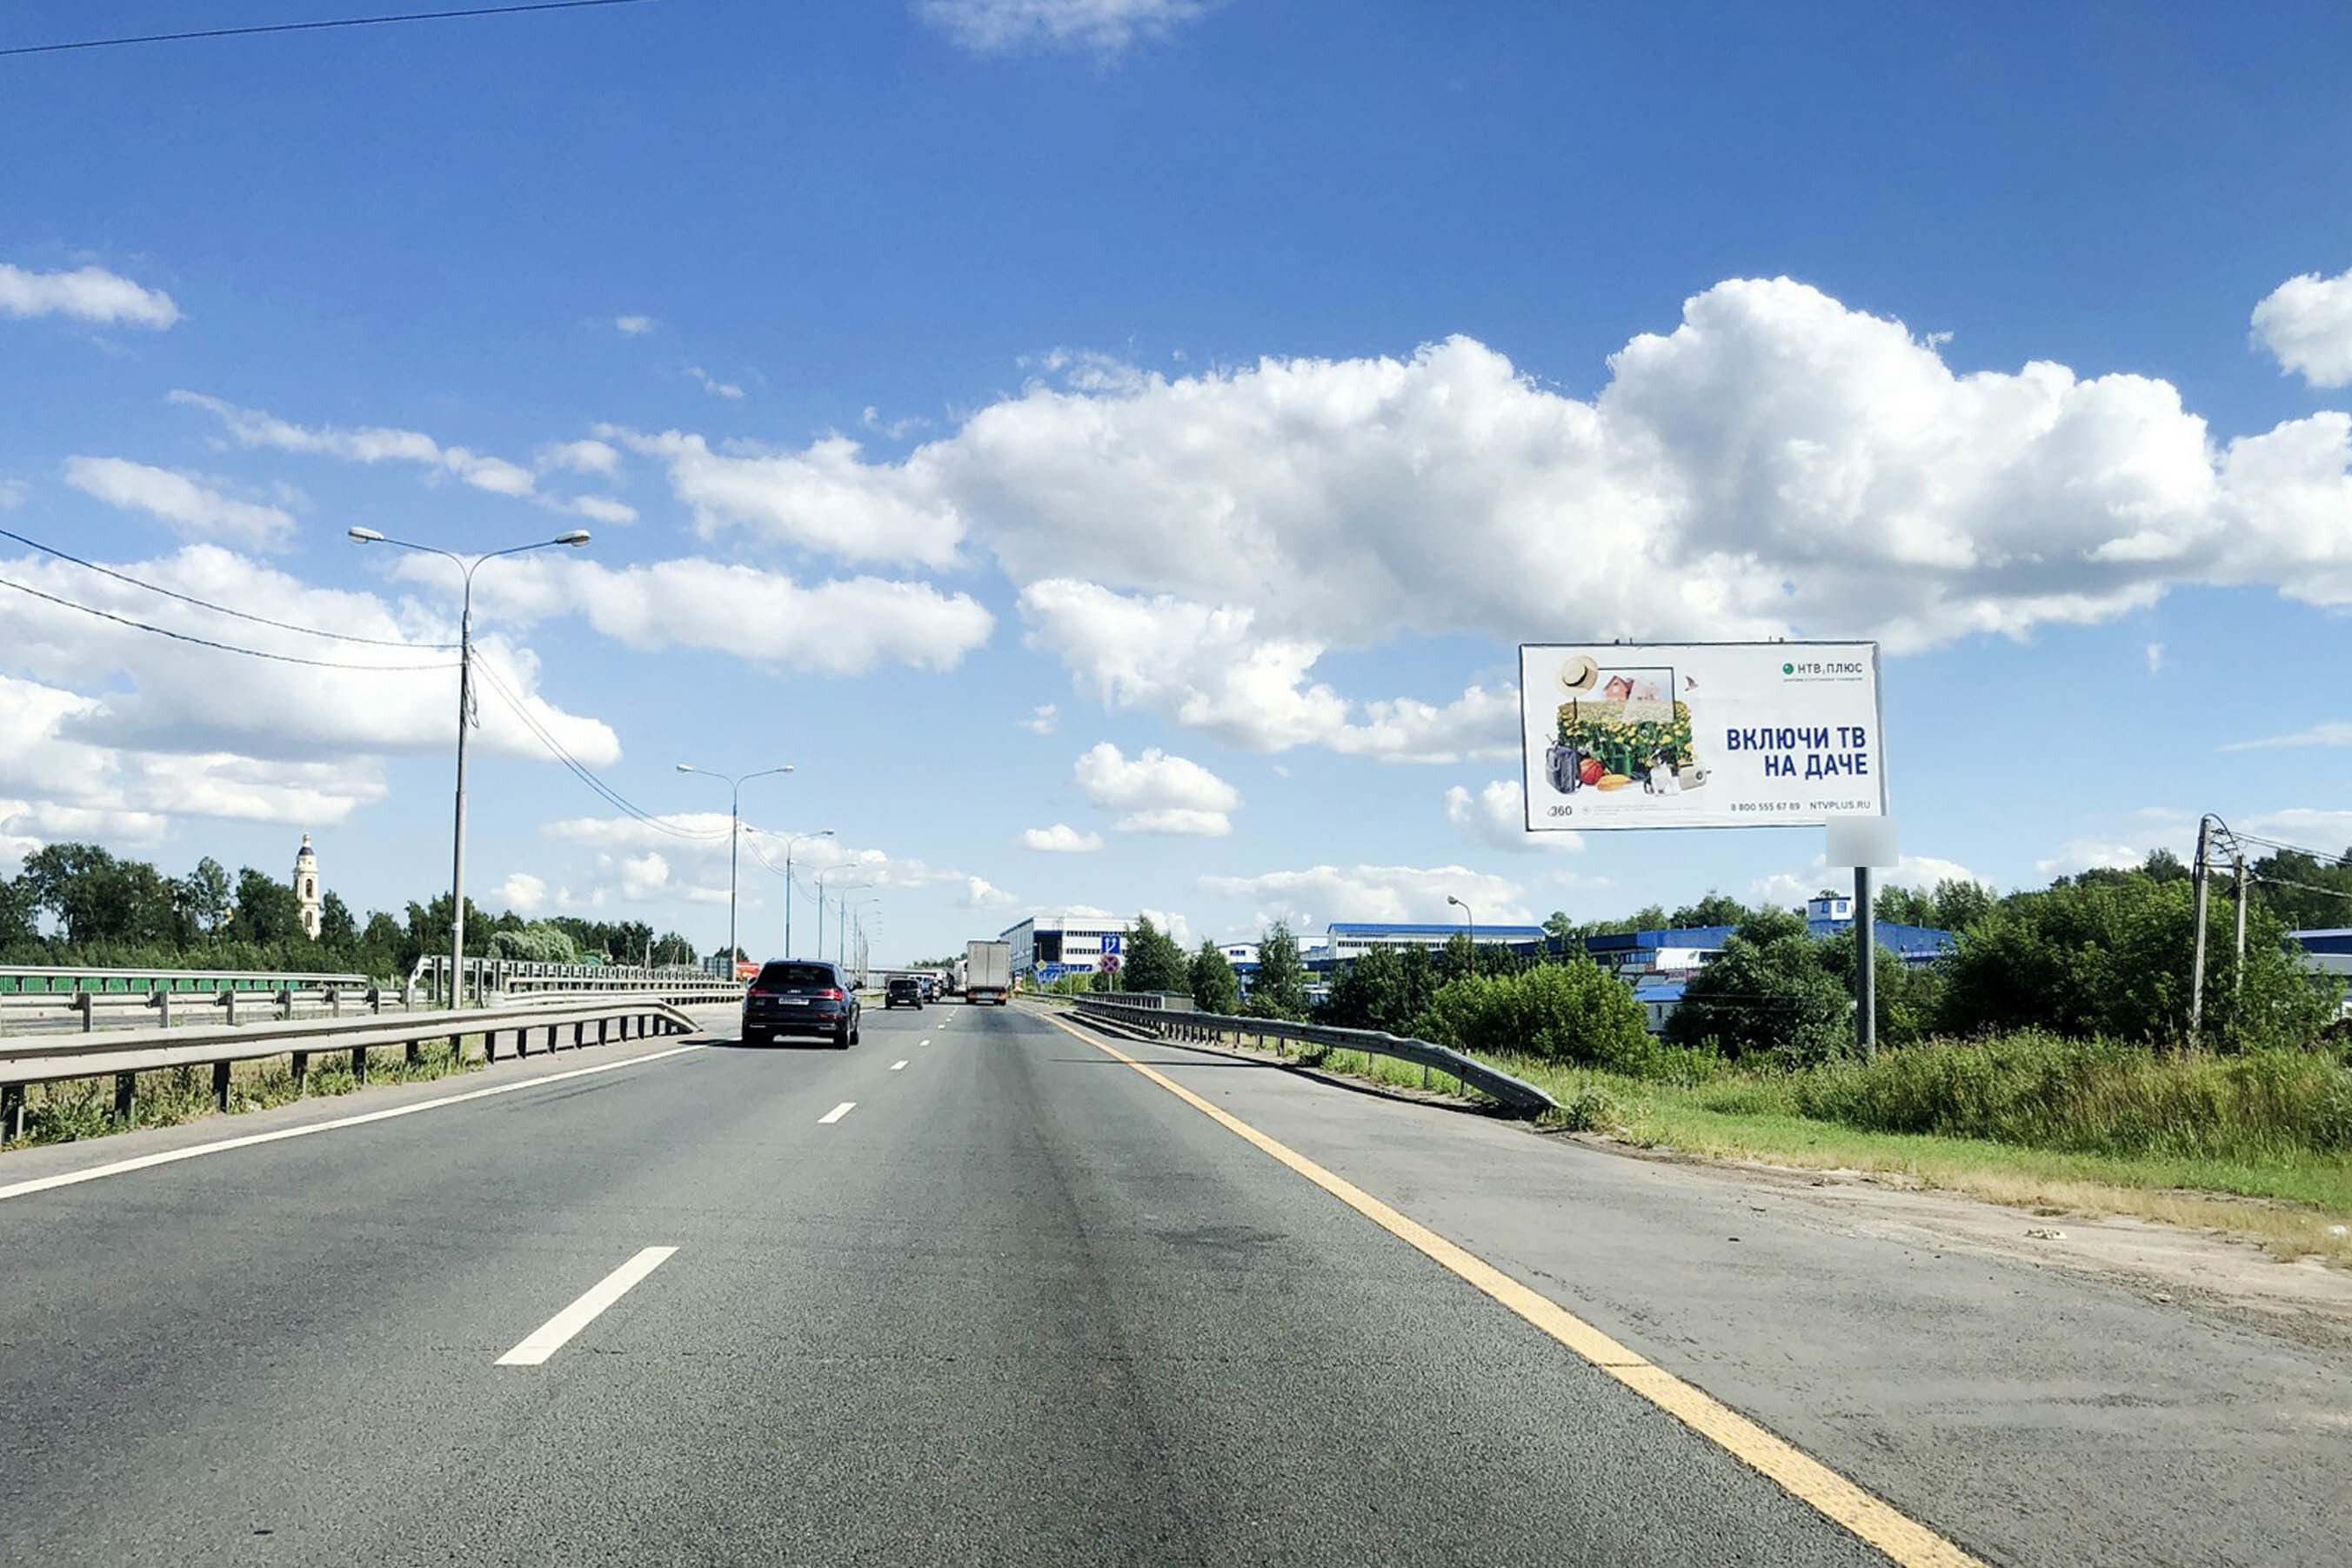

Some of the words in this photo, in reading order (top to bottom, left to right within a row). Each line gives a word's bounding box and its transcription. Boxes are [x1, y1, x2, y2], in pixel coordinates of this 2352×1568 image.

[1727, 727, 1829, 751] ВКЛЮЧИ
[1836, 726, 1867, 749] ТВ
[1765, 754, 1797, 777] НА
[1805, 753, 1868, 780] ДАЧЕ
[1551, 805, 1572, 817] 360
[1739, 803, 1756, 811] 800
[1759, 802, 1774, 811] 555
[1776, 802, 1787, 811] 67
[1789, 801, 1801, 811] 89
[1810, 801, 1870, 810] NTVPLUS.RU
